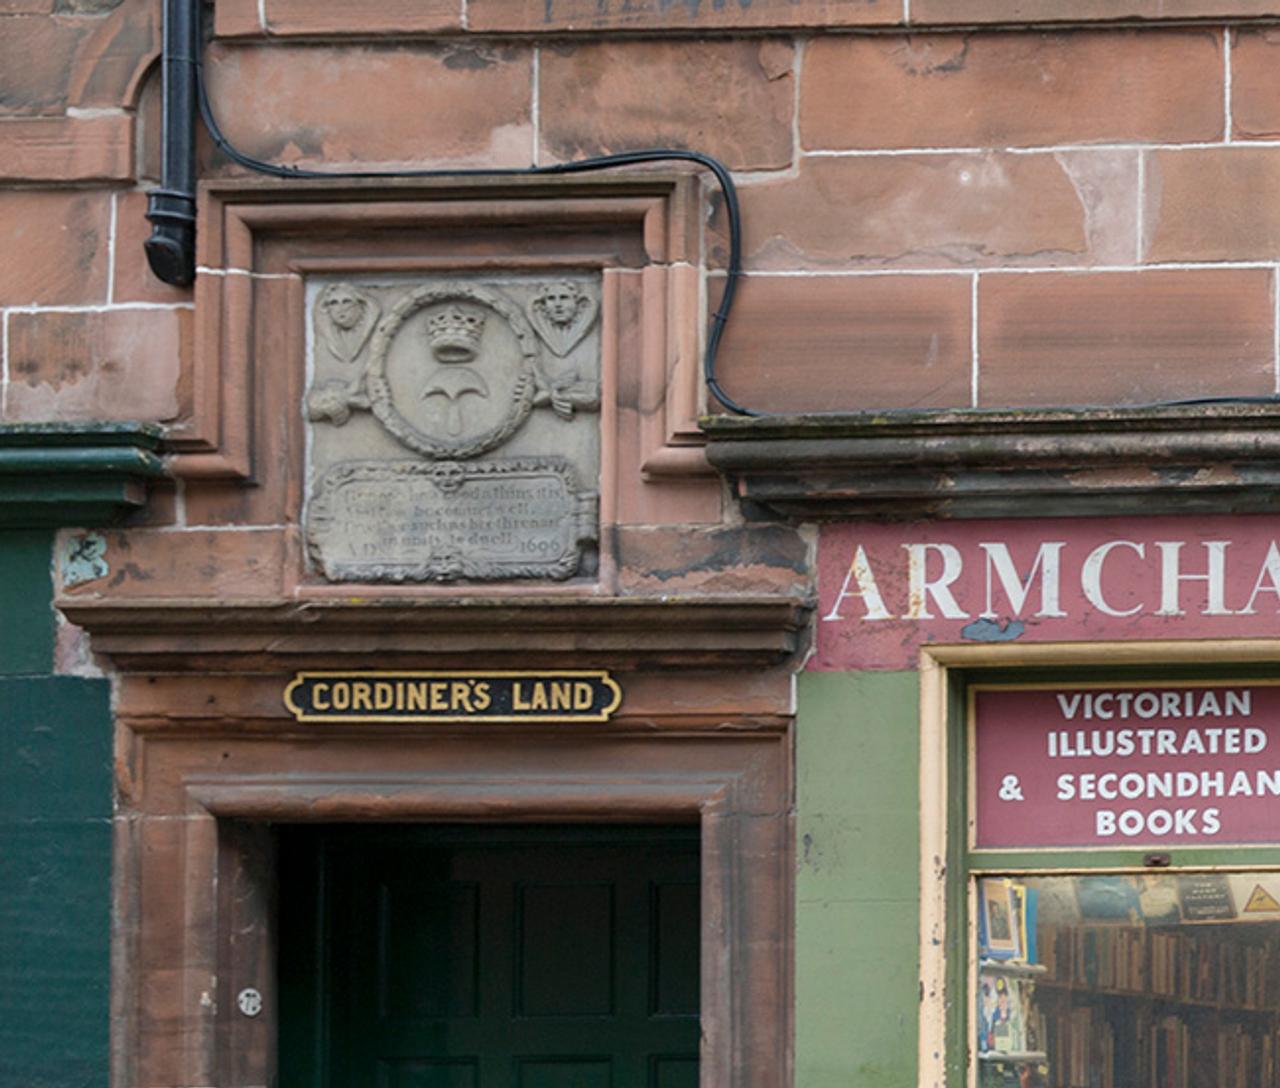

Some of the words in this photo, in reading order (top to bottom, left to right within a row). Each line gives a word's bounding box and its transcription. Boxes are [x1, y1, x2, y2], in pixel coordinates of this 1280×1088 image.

[520, 538, 561, 553] 1696
[312, 680, 491, 712] CORDINER'S
[512, 682, 593, 711] LAND
[1056, 690, 1251, 719] VICTORIAN
[1047, 728, 1268, 757] ILLUSTRATED
[998, 774, 1025, 801] &
[1096, 808, 1222, 836] BOOKS
